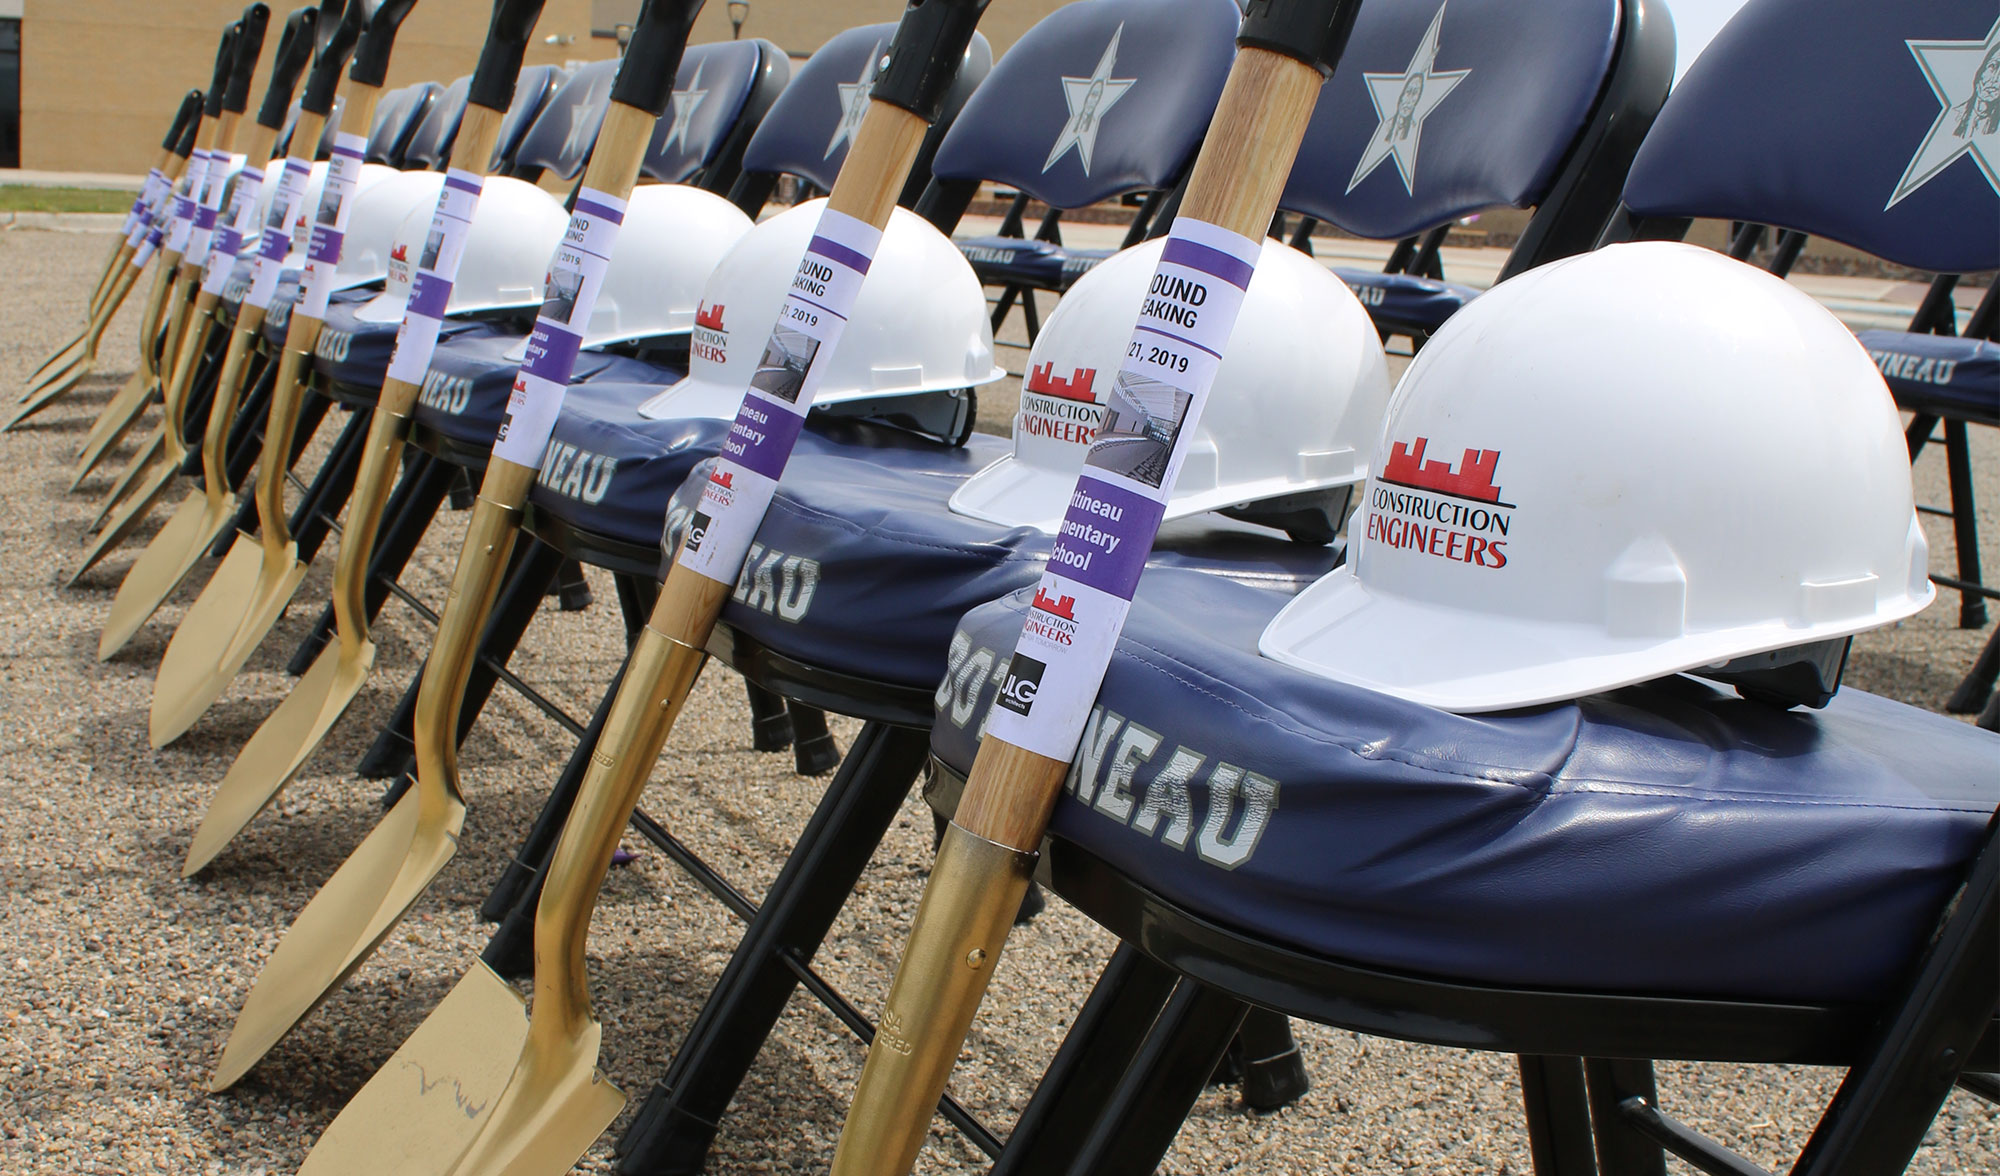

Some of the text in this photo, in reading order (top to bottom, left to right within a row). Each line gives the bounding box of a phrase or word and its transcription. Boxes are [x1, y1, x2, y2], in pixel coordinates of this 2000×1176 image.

[791, 307, 818, 327] 2019
[1128, 341, 1190, 373] 21, 2019
[1372, 487, 1511, 537] CONSTRUCTION
[1367, 513, 1508, 569] ENGINEERS
[1001, 674, 1038, 704] JLG
